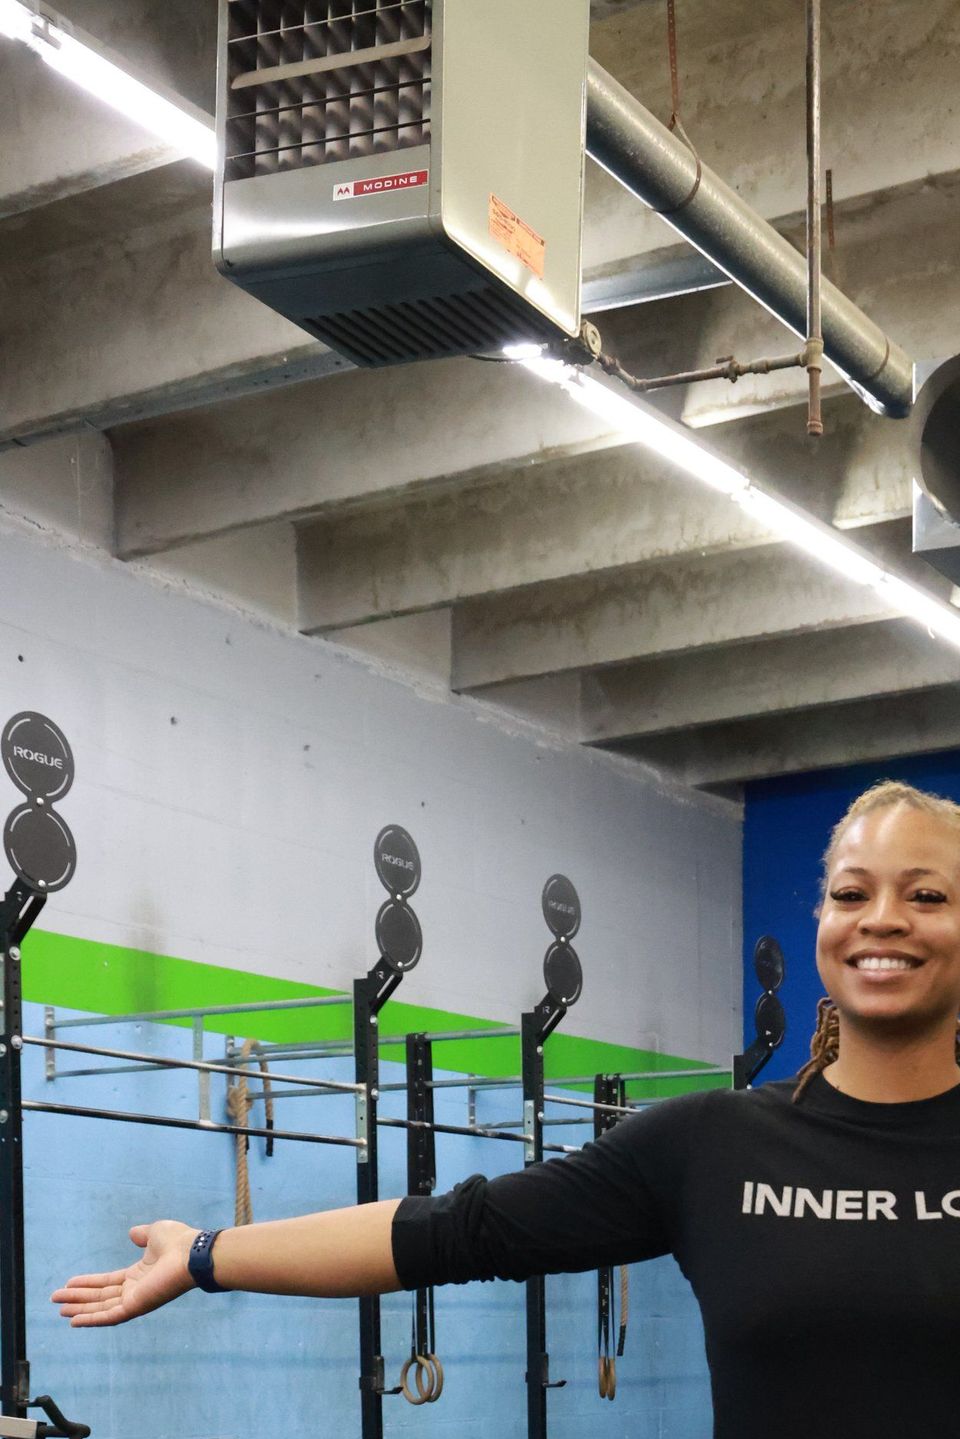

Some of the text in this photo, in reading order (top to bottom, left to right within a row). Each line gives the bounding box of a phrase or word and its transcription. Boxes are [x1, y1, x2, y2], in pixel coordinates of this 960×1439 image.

[363, 175, 418, 192] MODINE
[13, 745, 64, 770] ROGUE
[381, 853, 415, 871] ROGUE
[742, 1181, 899, 1220] INNER
